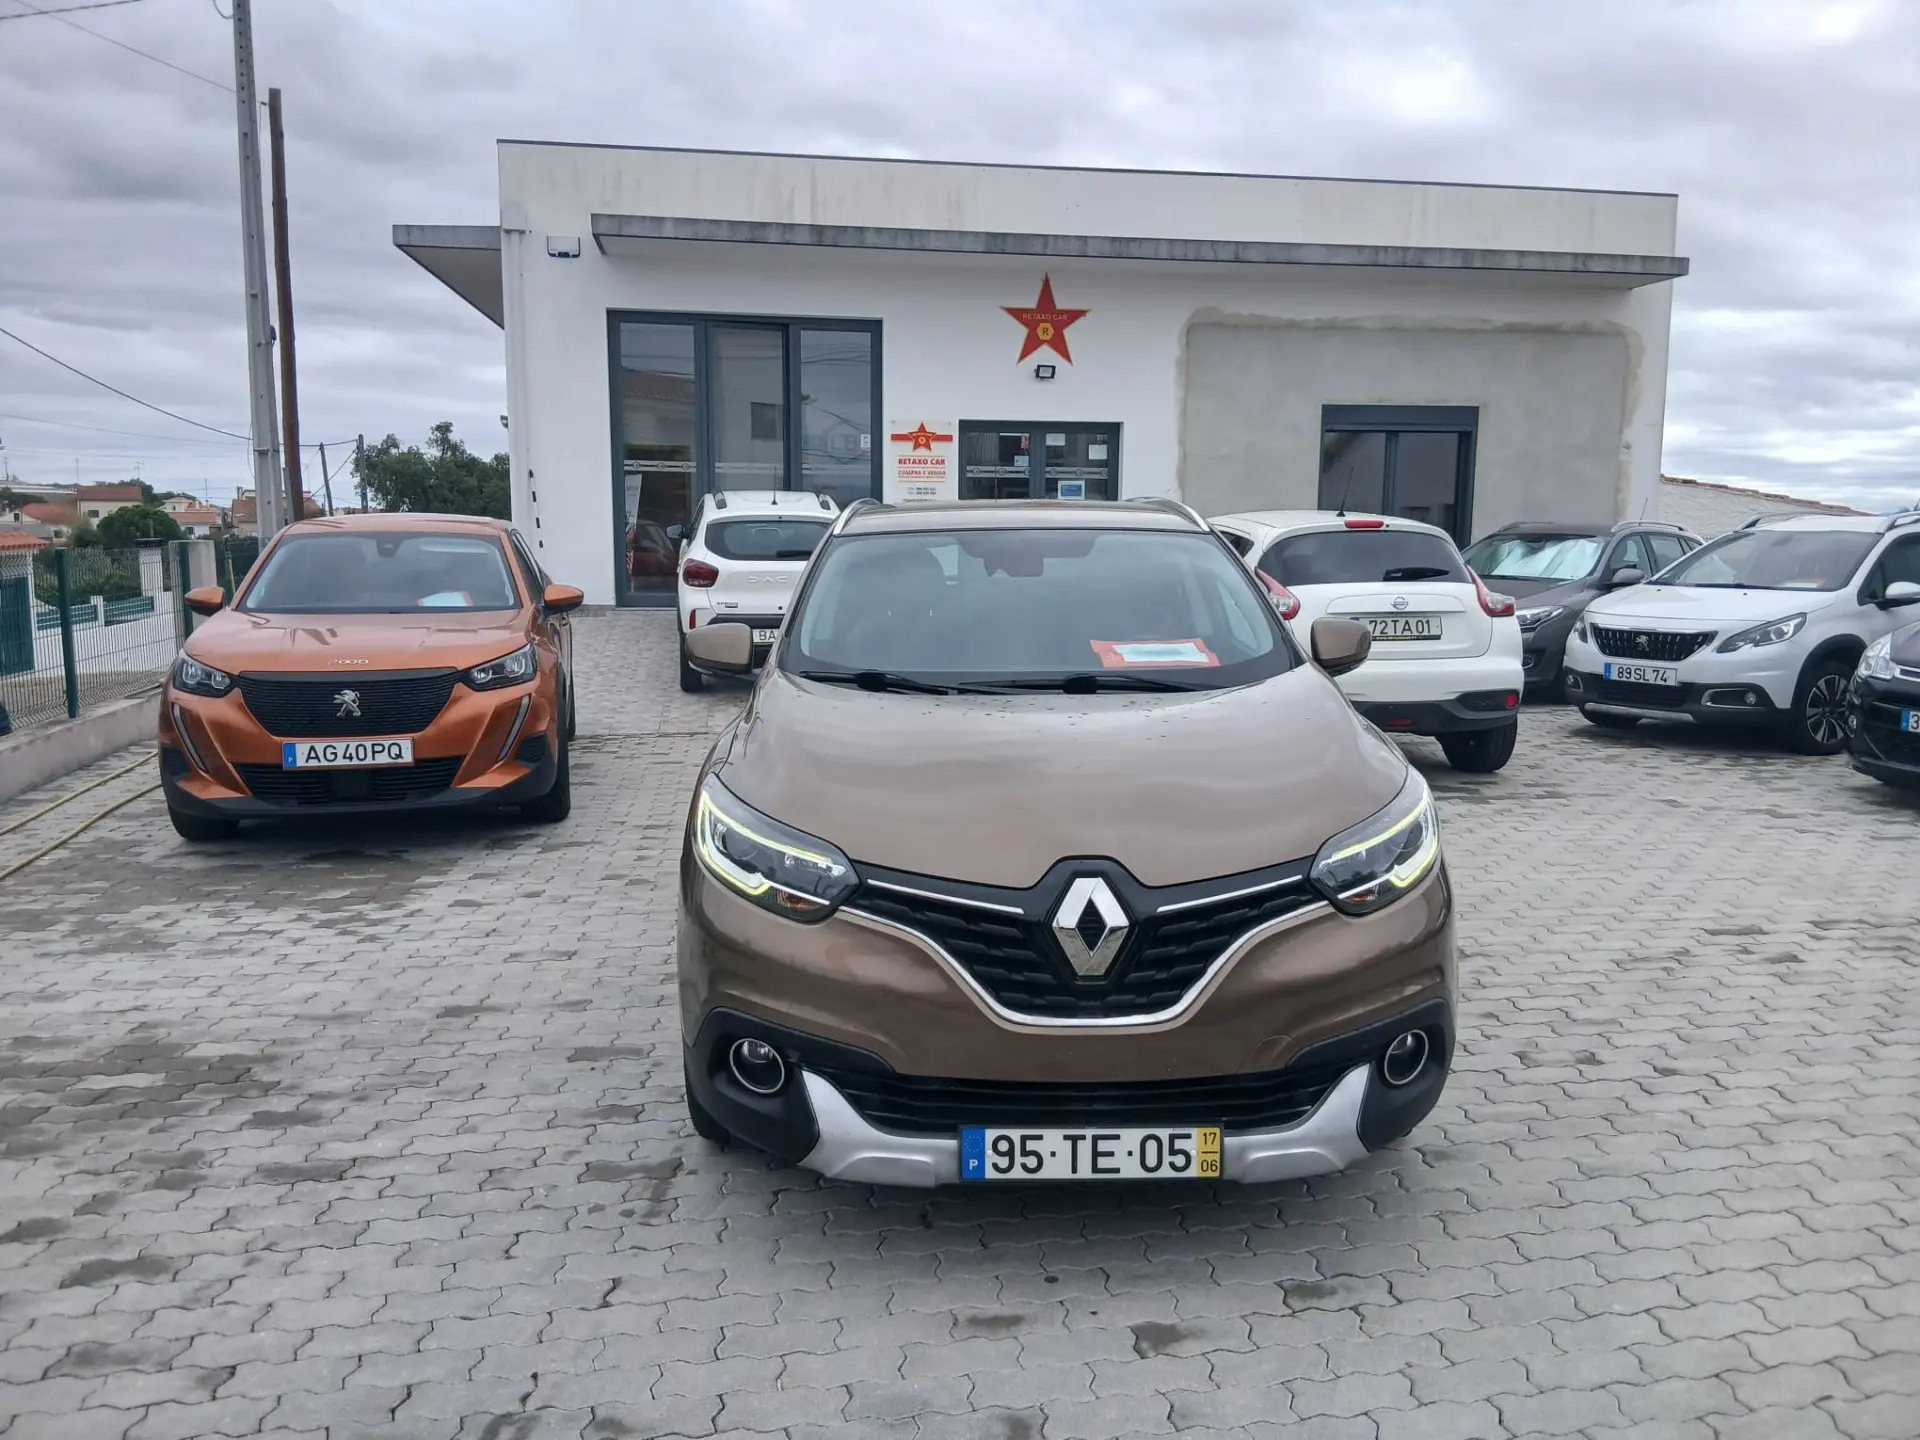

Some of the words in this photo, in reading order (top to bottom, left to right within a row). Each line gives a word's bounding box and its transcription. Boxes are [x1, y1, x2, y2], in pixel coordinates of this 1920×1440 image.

[1042, 327, 1049, 336] R
[1203, 1132, 1217, 1145] 17
[969, 1159, 979, 1171] P
[1200, 1159, 1219, 1173] 06
